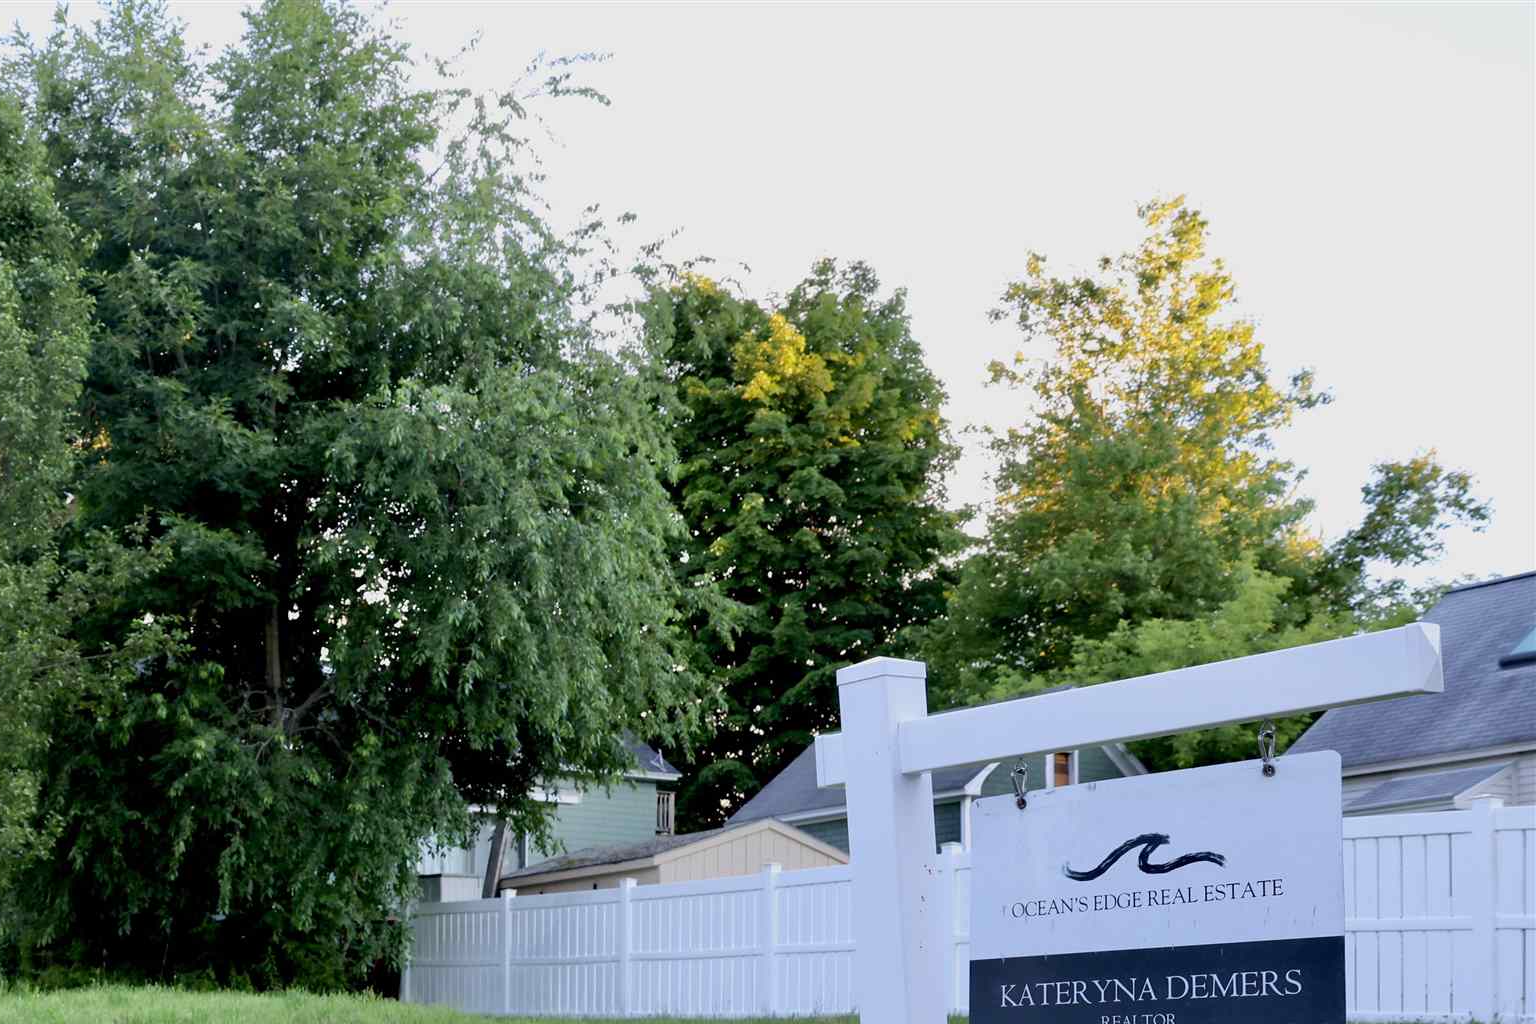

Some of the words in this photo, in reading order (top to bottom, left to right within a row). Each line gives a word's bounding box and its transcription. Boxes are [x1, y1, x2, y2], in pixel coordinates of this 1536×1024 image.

[1011, 896, 1089, 919] OCEAN'S
[1093, 891, 1143, 912] EDGE
[1147, 885, 1199, 907] REAL
[1203, 878, 1285, 902] ESTATE
[1000, 977, 1157, 1008] KATERYNA
[1165, 968, 1303, 1001] DEMERS
